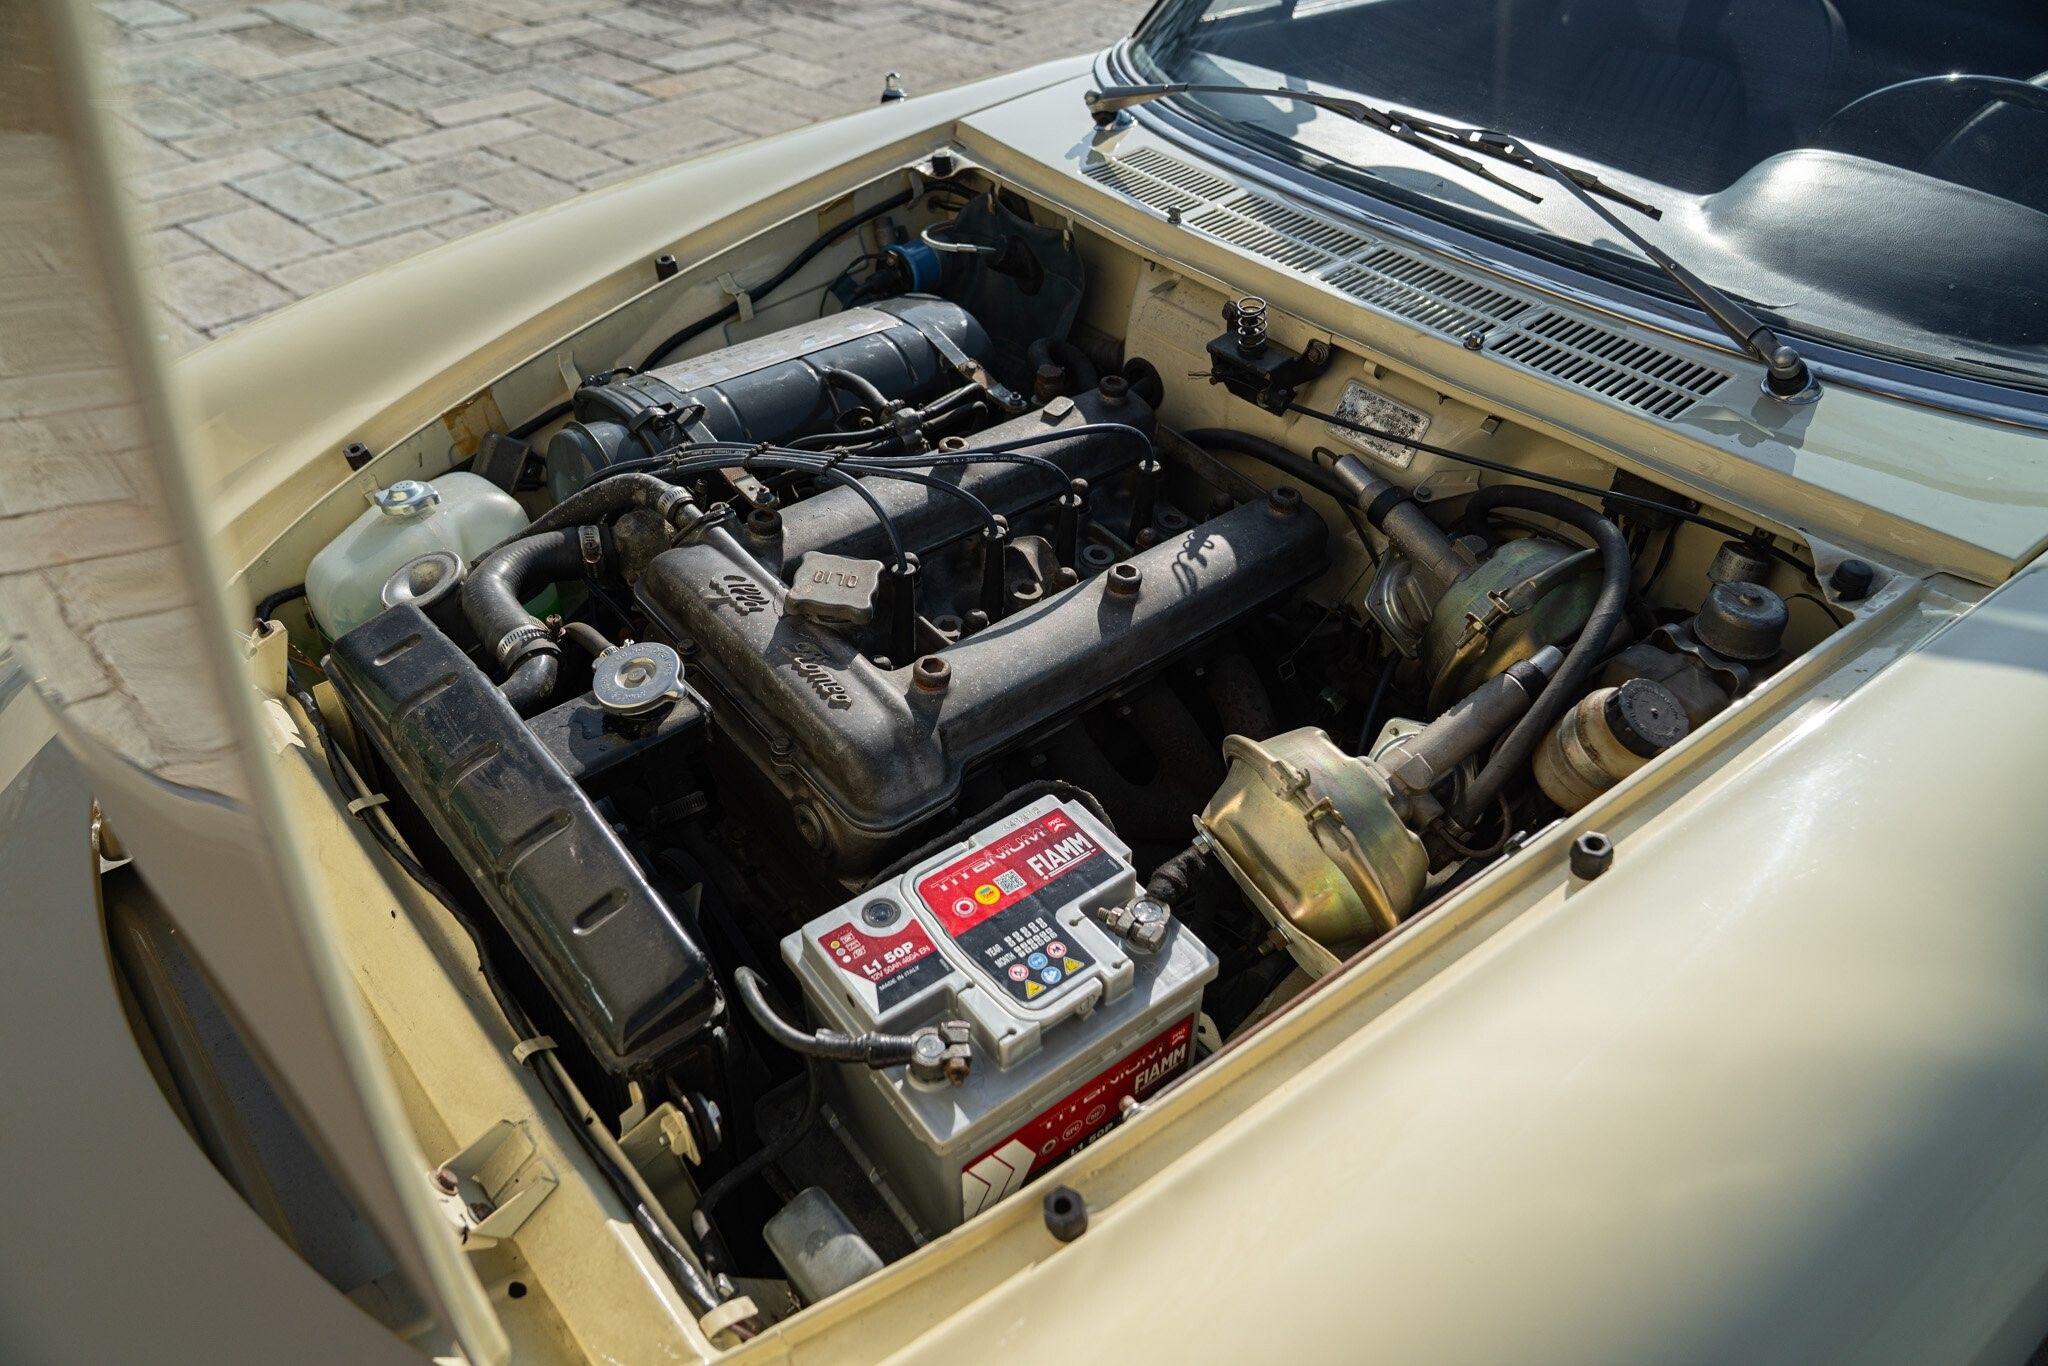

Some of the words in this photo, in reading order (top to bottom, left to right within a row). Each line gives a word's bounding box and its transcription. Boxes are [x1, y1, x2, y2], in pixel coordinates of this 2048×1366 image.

[813, 569, 859, 588] OLIO
[1047, 817, 1062, 828] PRO
[1026, 831, 1094, 877] FIAMM
[862, 959, 882, 976] L1
[883, 941, 914, 964] 50P
[985, 943, 1003, 958] YEAR
[994, 951, 1017, 969] MONTH
[870, 970, 884, 982] 12V
[878, 978, 897, 992] MADE
[904, 965, 920, 979] ITALY
[1135, 1043, 1186, 1090] FIAMM
